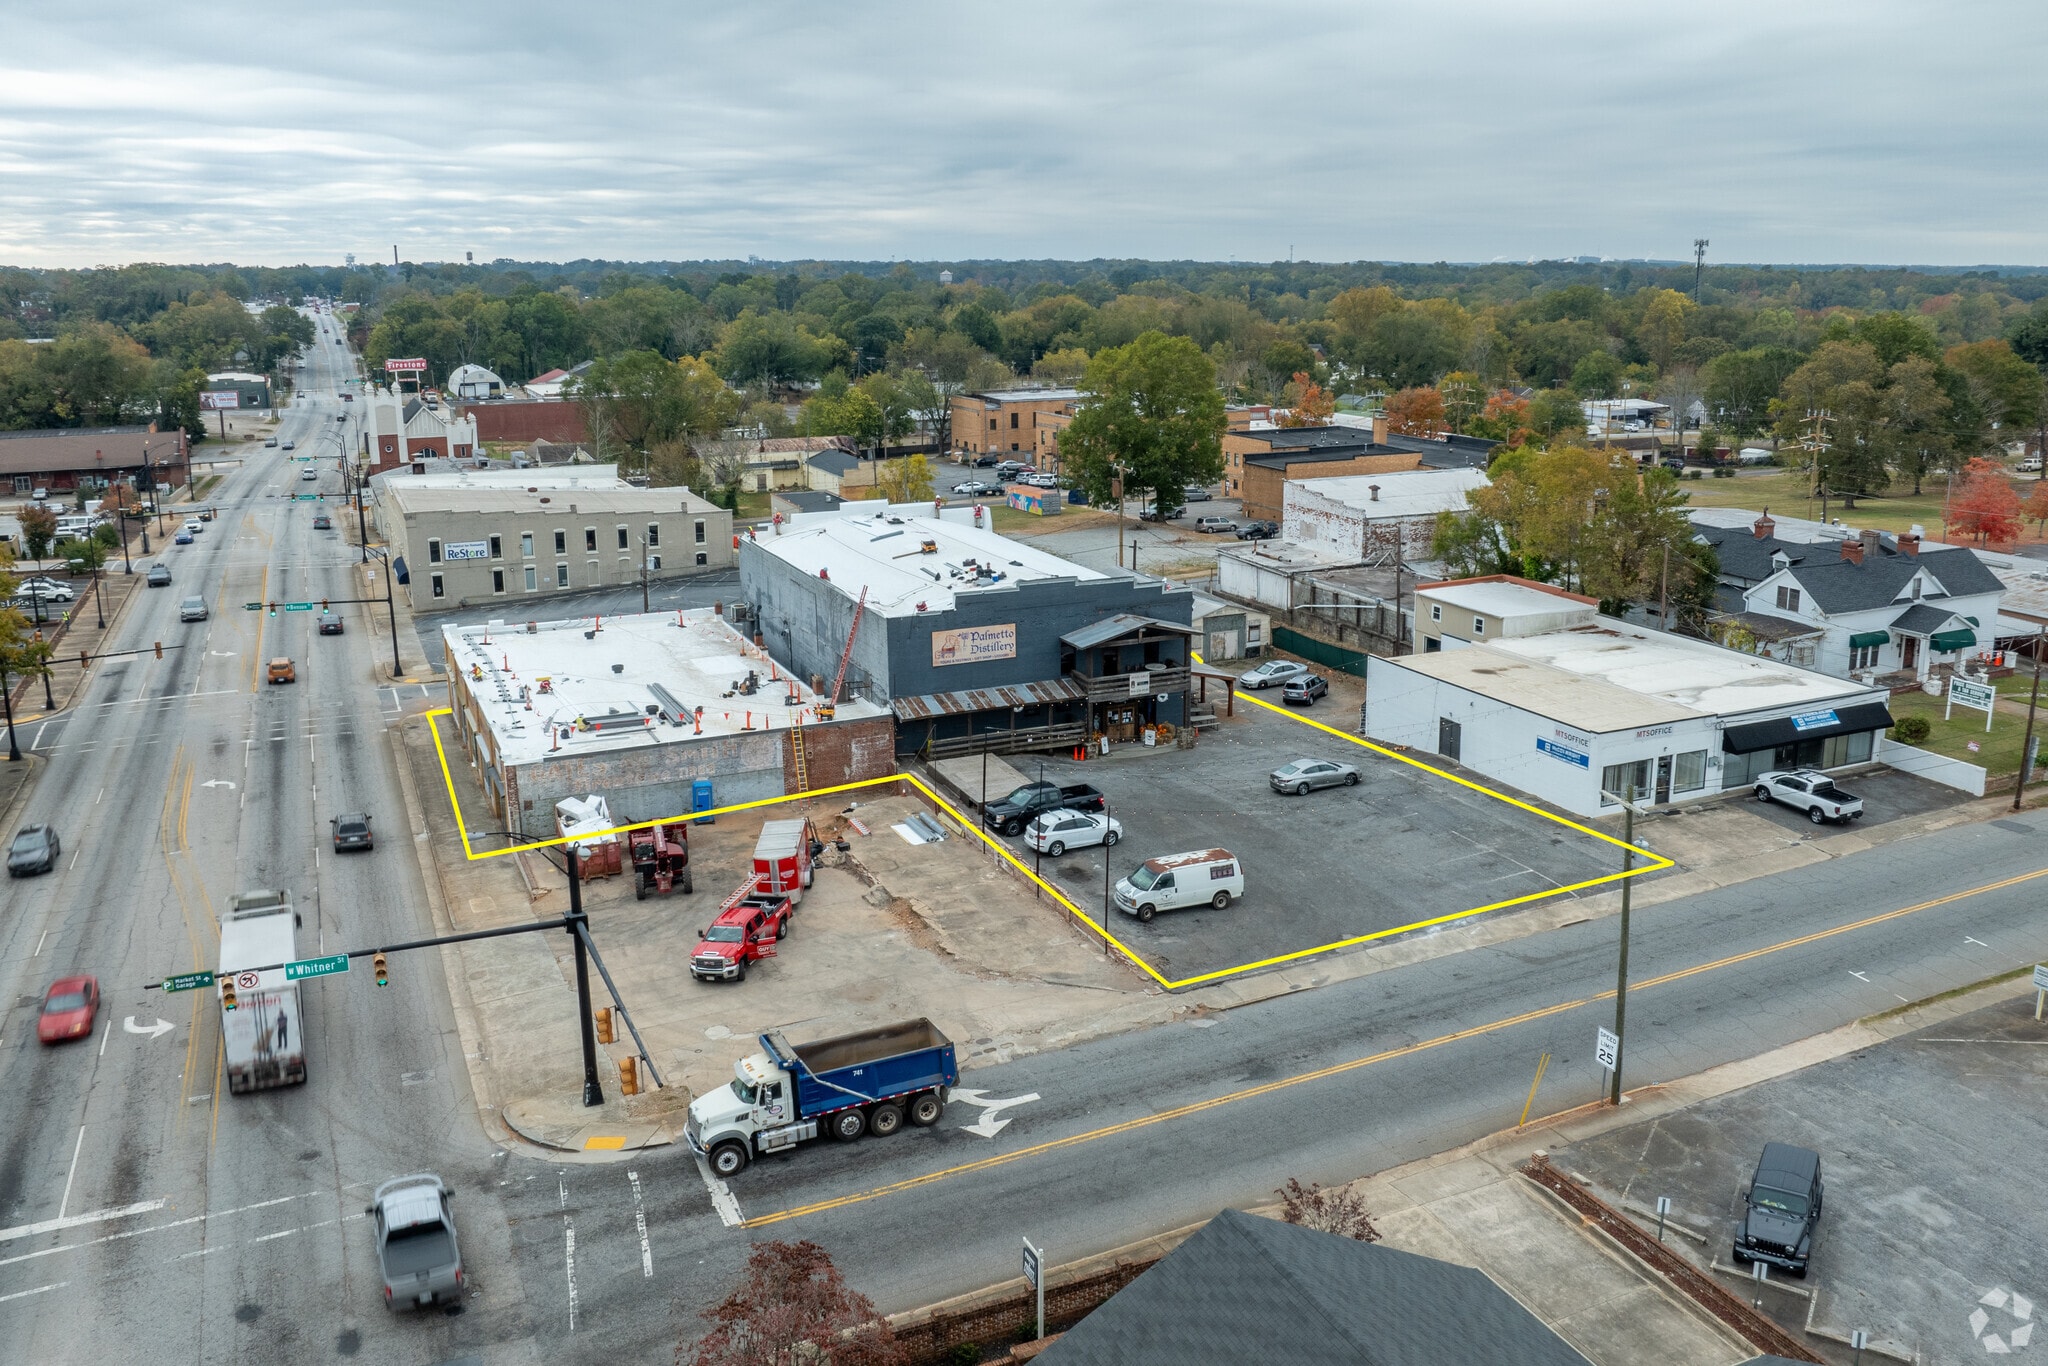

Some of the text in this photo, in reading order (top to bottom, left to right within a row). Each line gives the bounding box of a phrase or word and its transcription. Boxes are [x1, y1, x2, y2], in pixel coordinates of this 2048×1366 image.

[387, 361, 425, 369] Firestone
[447, 549, 485, 559] ReStore
[970, 629, 1014, 644] Palmetto
[970, 641, 1014, 655] Distillery
[1636, 726, 1673, 738] MTSOFFICE
[1555, 729, 1589, 748] MTSOFFICE
[295, 962, 336, 976] Whitner
[337, 956, 345, 964] St
[163, 981, 171, 990] P
[174, 975, 195, 984] Market
[175, 981, 196, 989] Garage
[1600, 1031, 1617, 1045] SPEED
[1598, 1048, 1614, 1065] 25
[852, 1069, 863, 1077] 741
